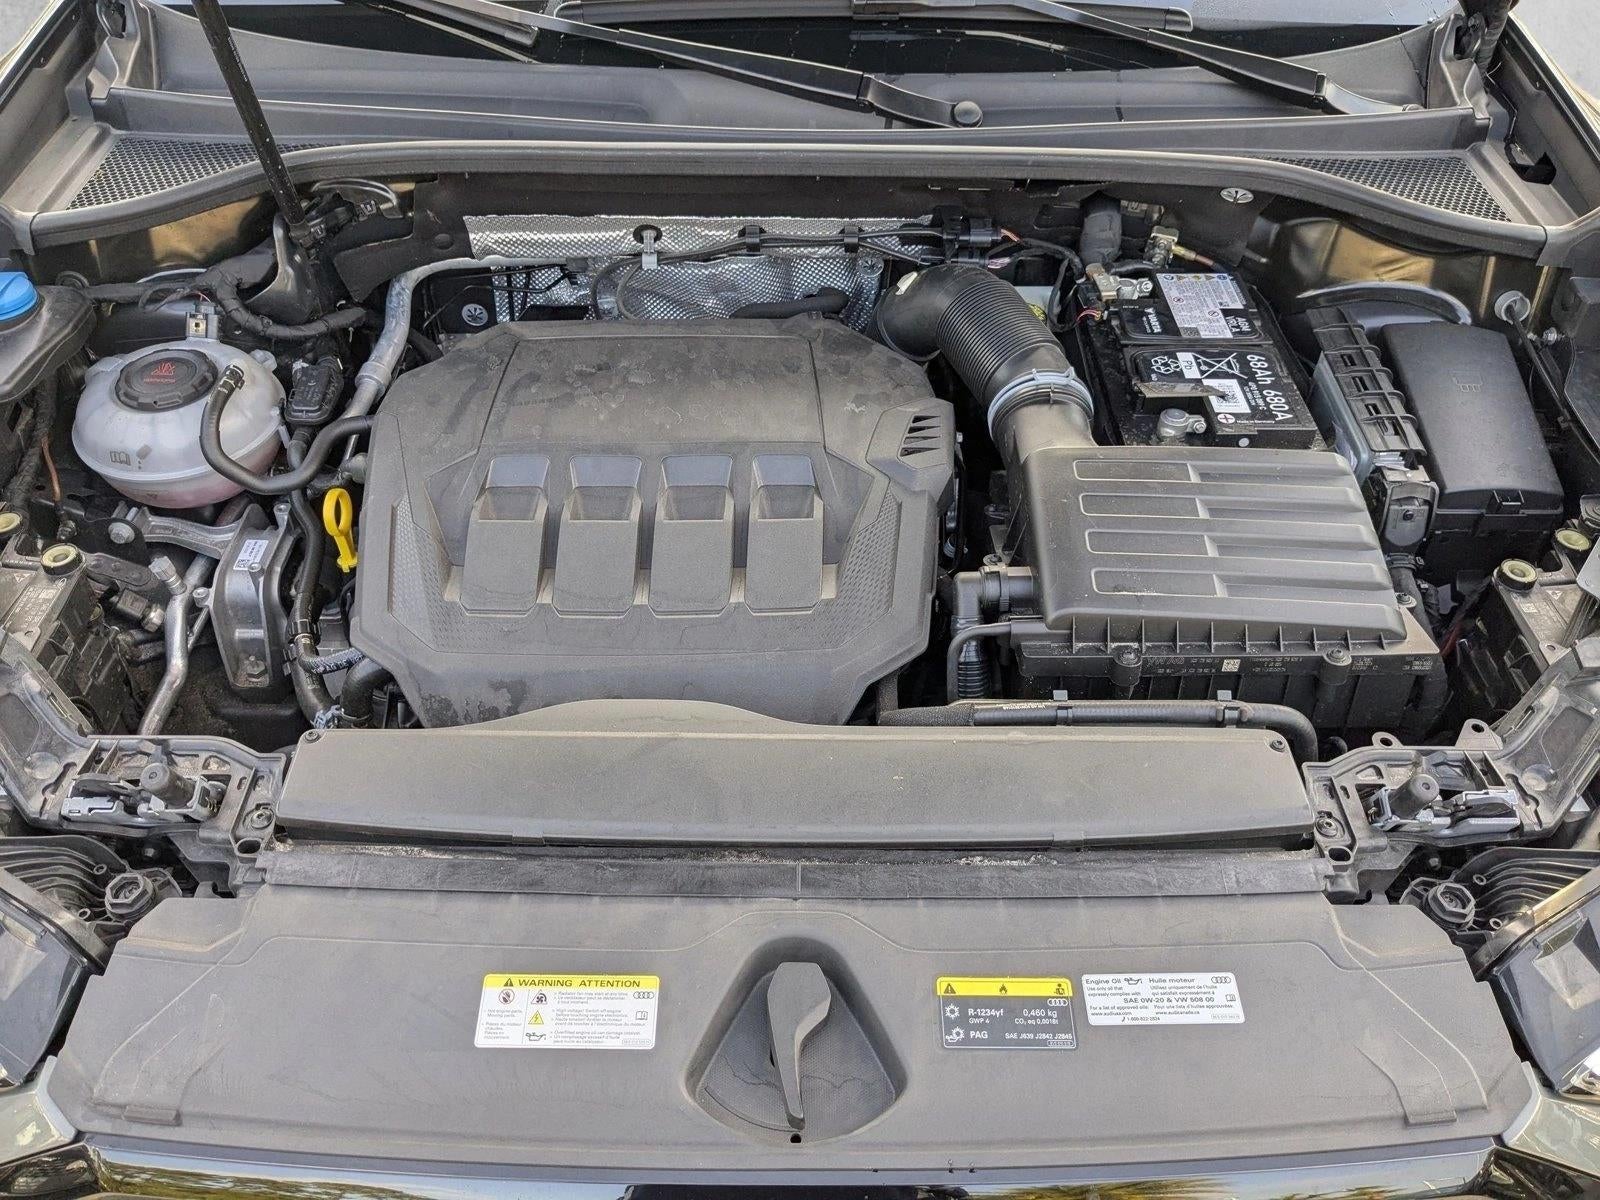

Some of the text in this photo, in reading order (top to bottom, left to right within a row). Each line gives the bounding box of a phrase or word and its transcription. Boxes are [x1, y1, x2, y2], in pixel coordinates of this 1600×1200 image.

[1148, 313, 1162, 333] VARTA
[1235, 317, 1251, 331] AGM
[1185, 360, 1193, 370] Pb
[1247, 354, 1275, 384] 68Ah
[1263, 389, 1295, 421] 680A
[519, 979, 640, 988] WARNING ATTENTION
[968, 1008, 1004, 1018] R-1234yf
[1023, 1009, 1057, 1019] 0,460 kg
[970, 1031, 988, 1039] PAG
